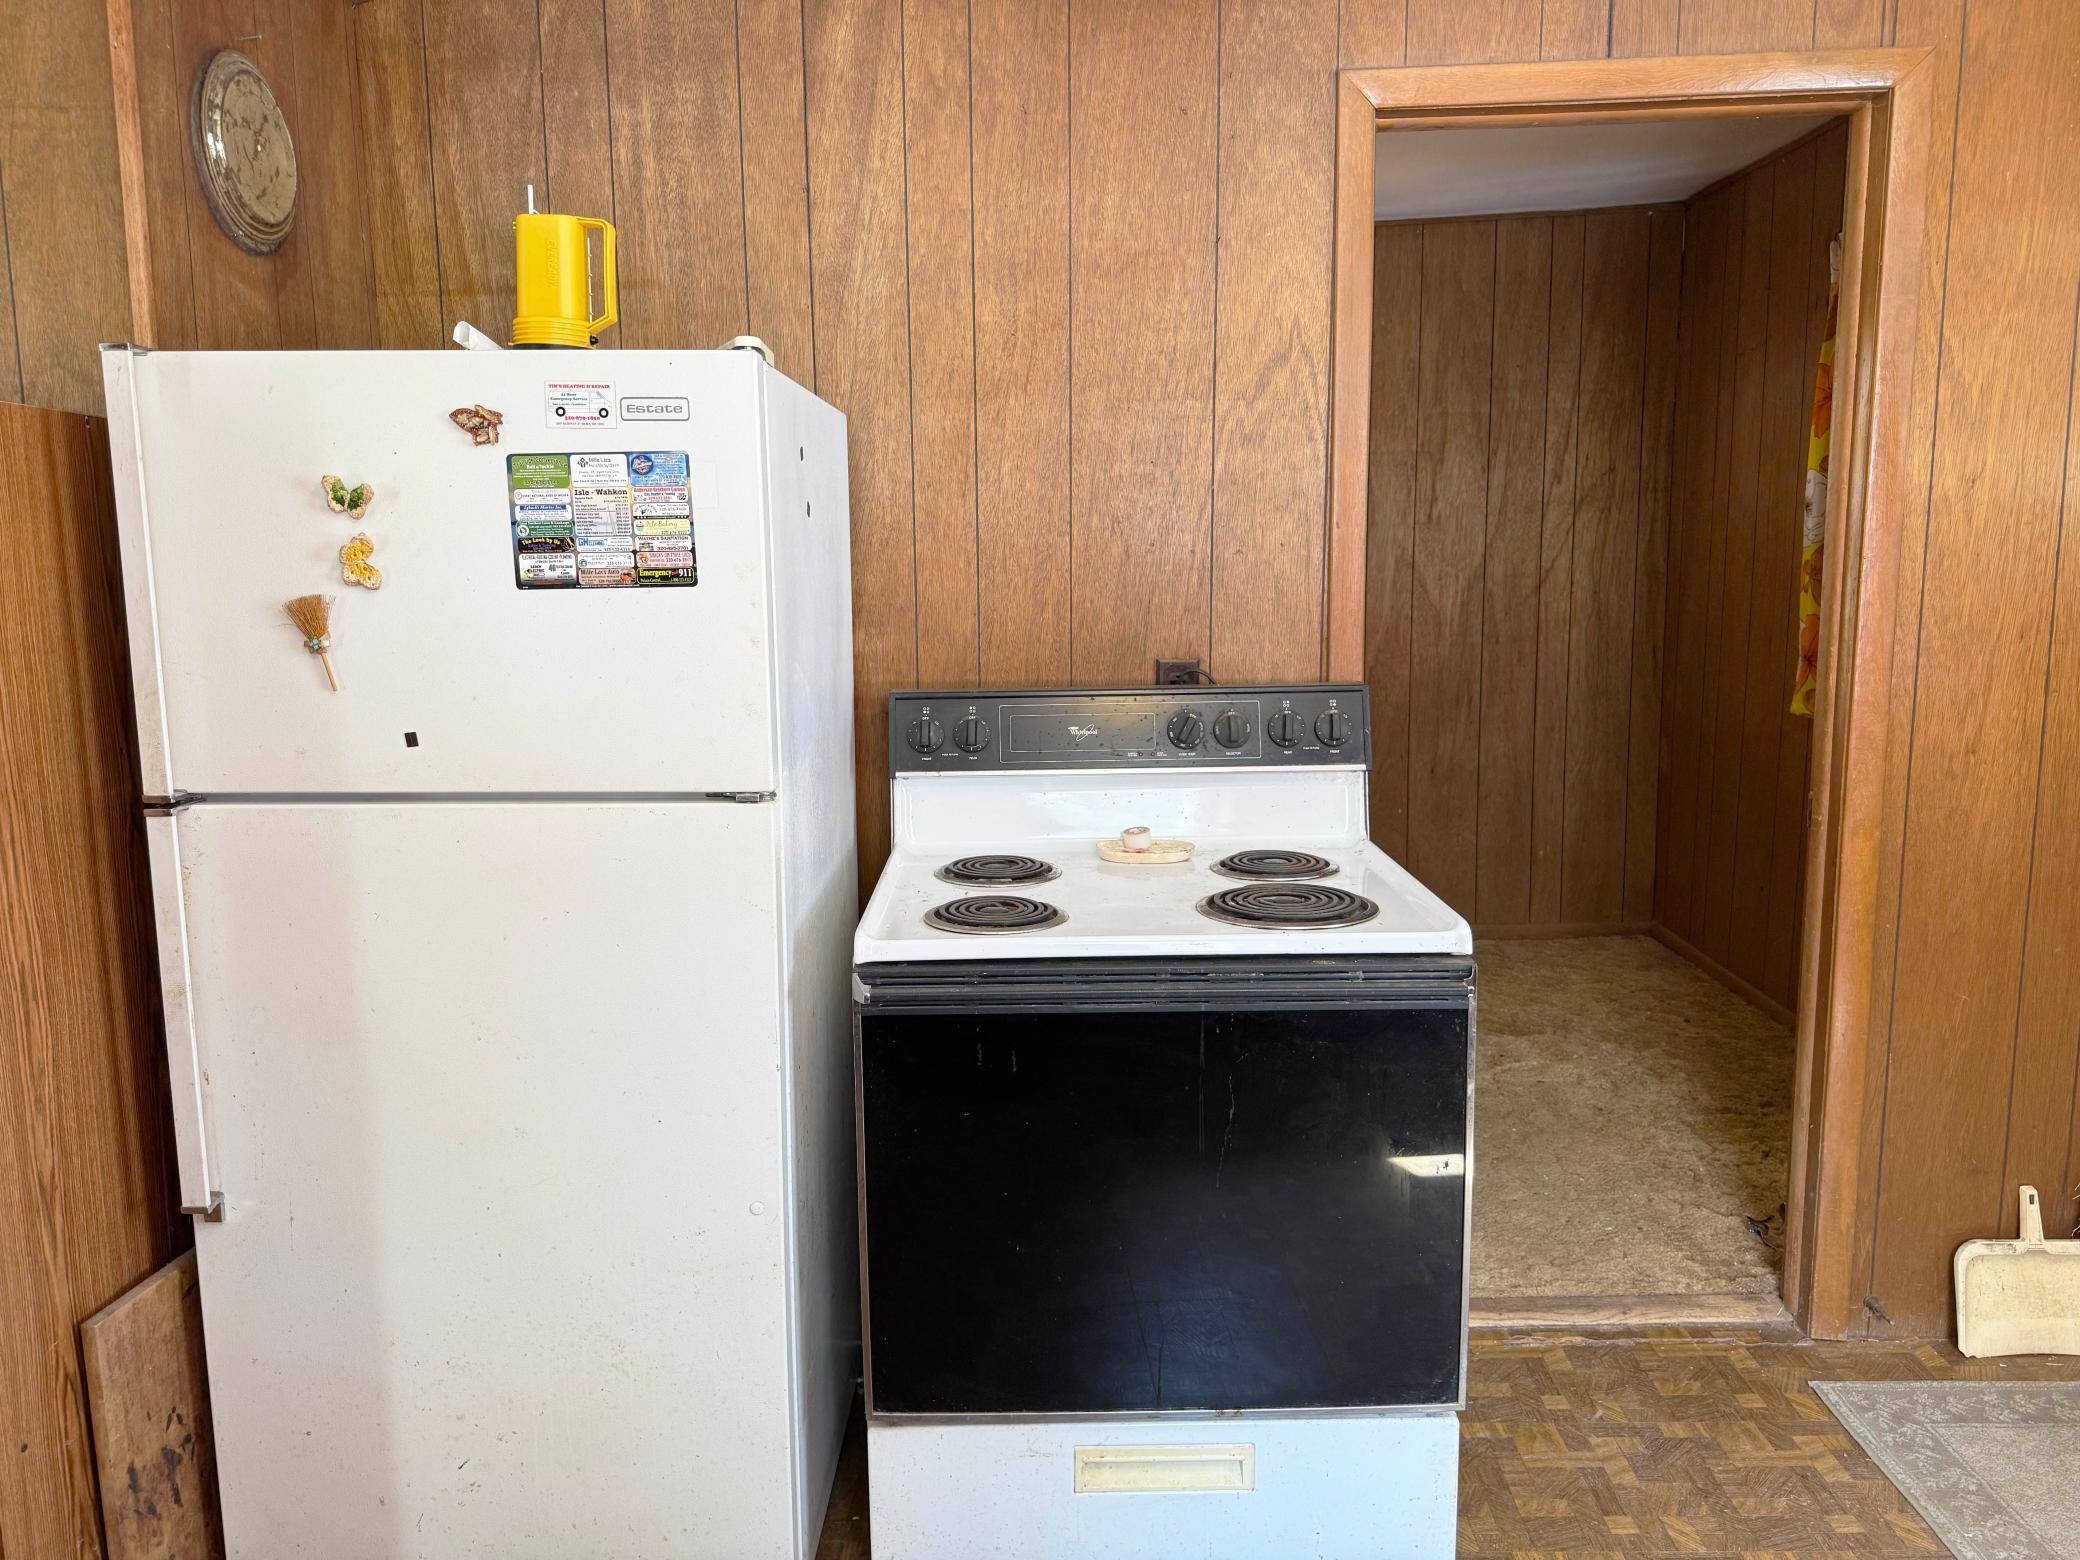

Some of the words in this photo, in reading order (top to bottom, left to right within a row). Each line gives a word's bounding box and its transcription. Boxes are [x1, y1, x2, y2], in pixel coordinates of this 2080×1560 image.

[626, 404, 683, 414] Estate
[639, 569, 671, 578] Emergency
[678, 568, 692, 576] 911
[1069, 726, 1098, 735] Whirlpool
